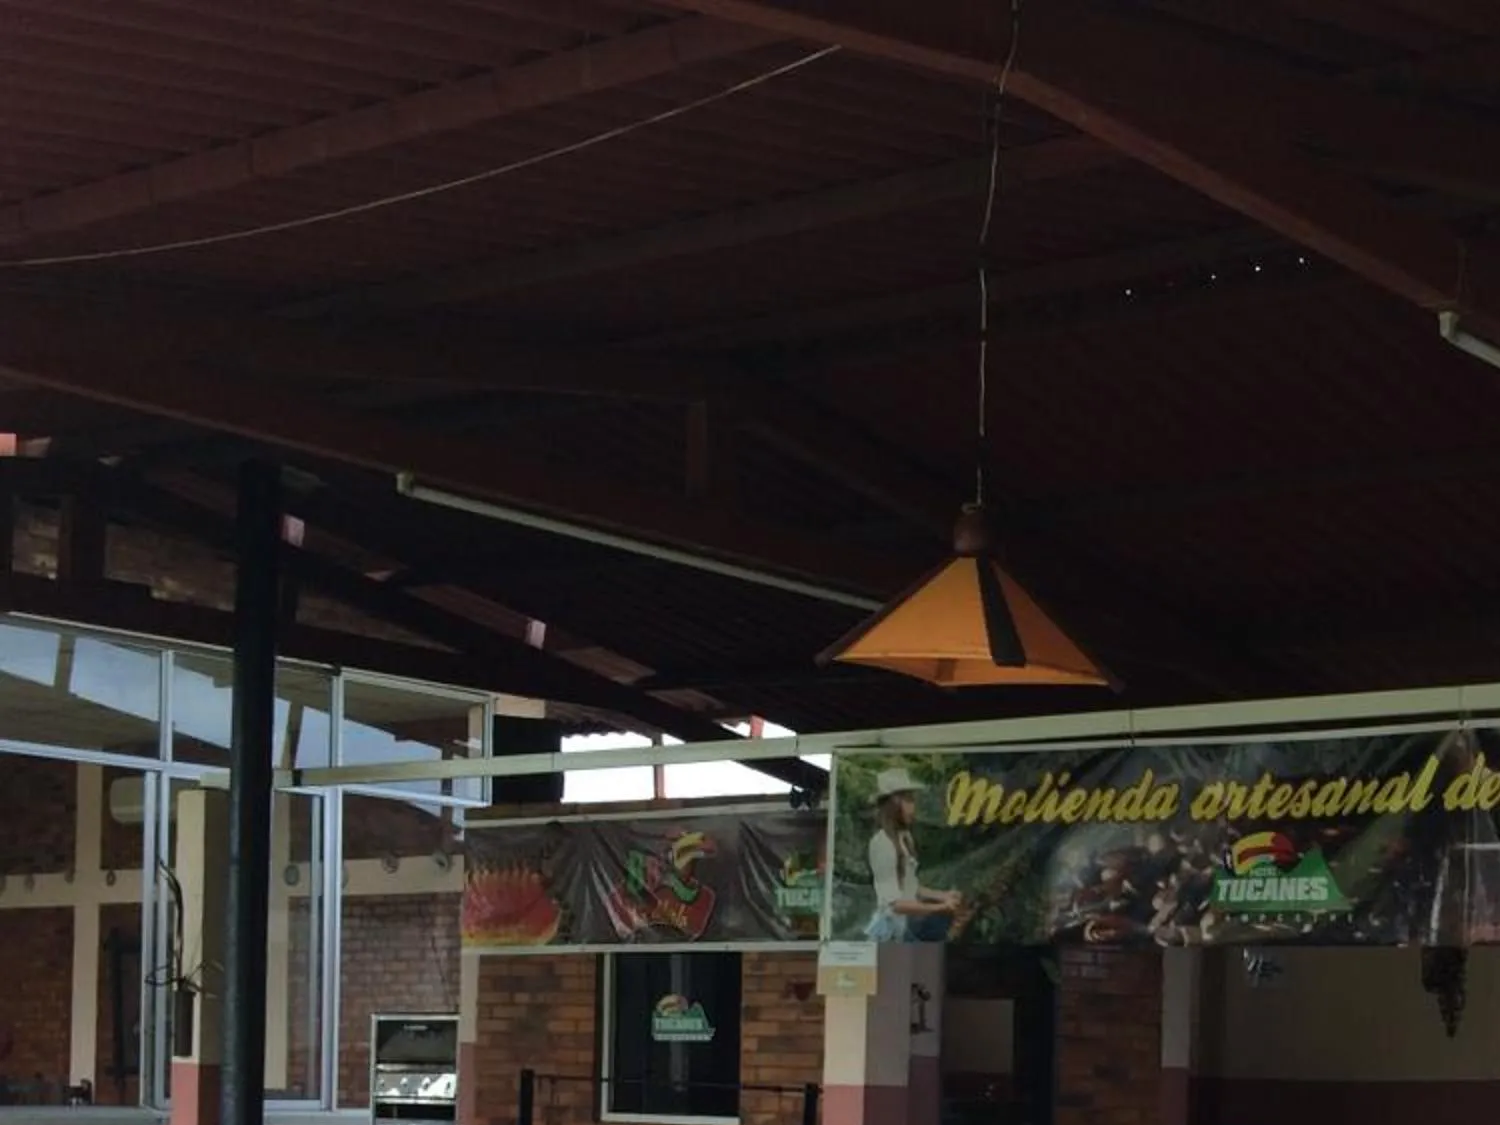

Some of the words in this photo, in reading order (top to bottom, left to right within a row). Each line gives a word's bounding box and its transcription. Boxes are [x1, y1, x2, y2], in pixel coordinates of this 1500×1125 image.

[946, 768, 1180, 826] Molienda
[1190, 754, 1434, 820] artesanal
[774, 887, 826, 907] TUCA
[1217, 876, 1329, 901] TUCANES
